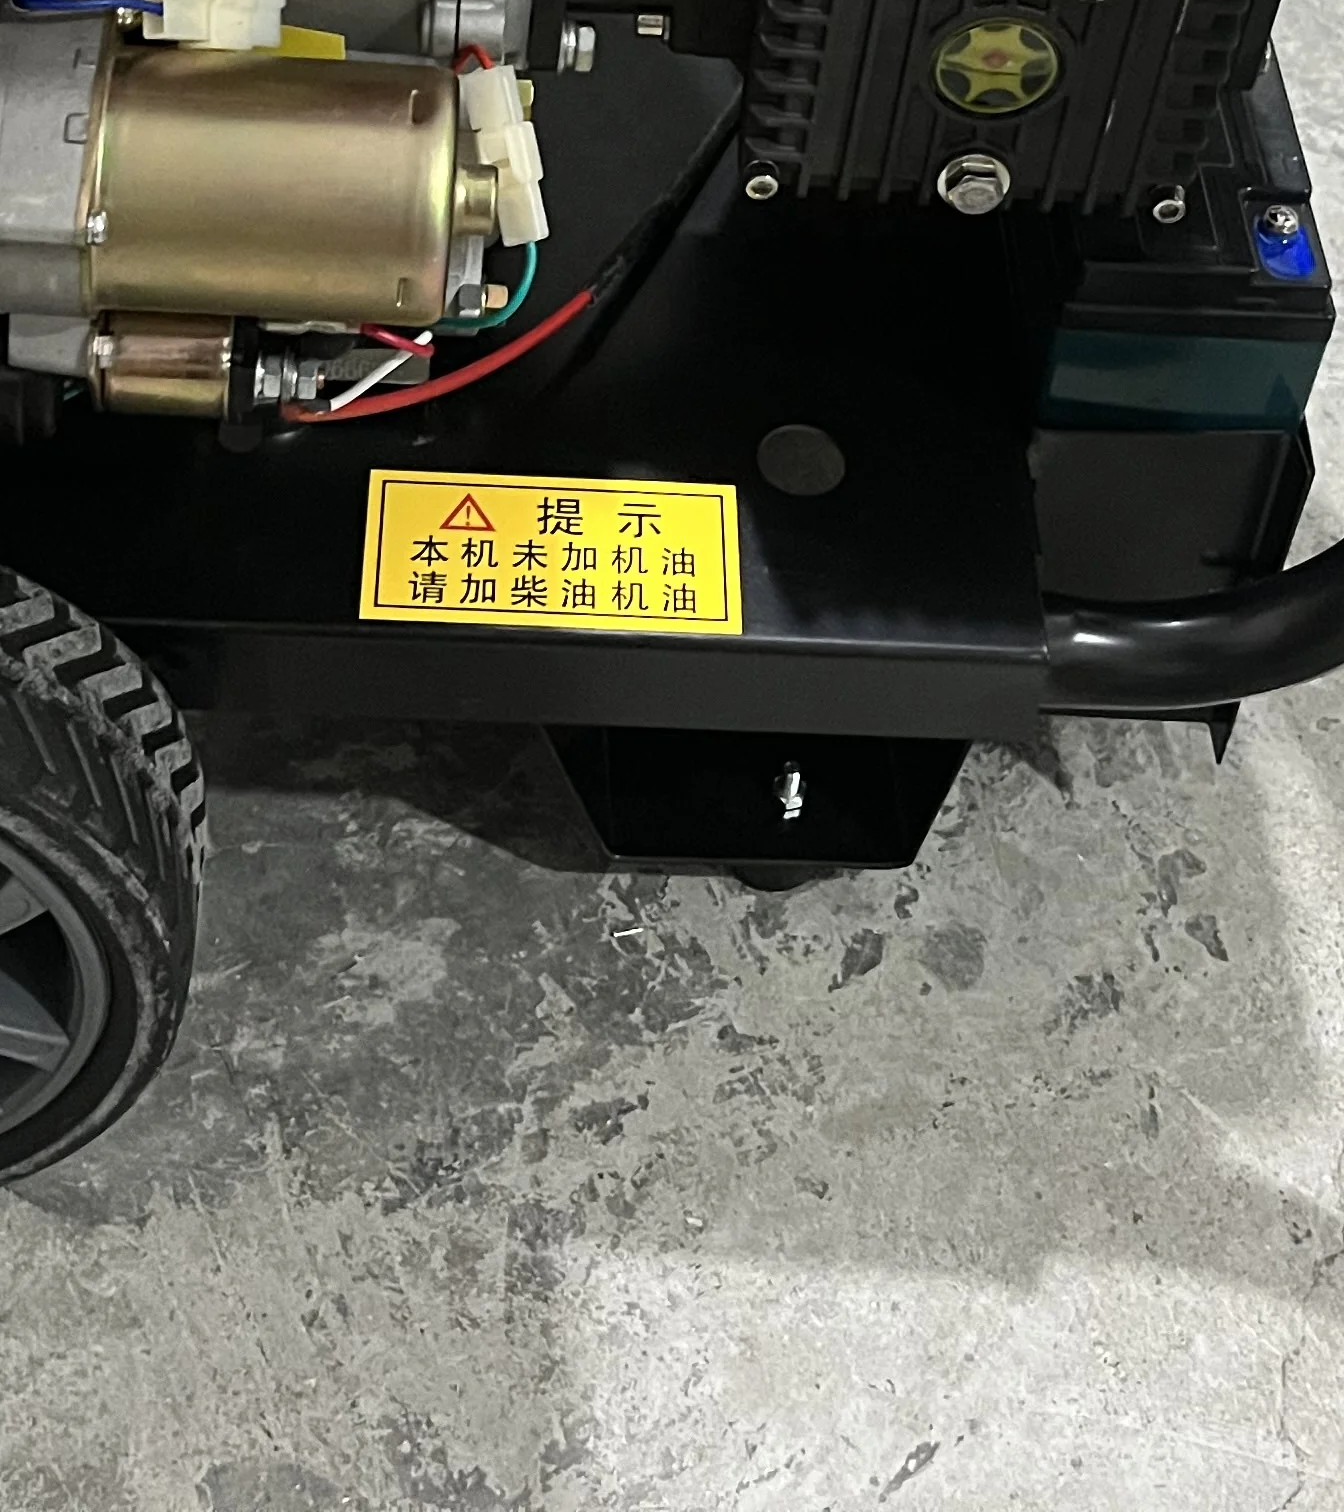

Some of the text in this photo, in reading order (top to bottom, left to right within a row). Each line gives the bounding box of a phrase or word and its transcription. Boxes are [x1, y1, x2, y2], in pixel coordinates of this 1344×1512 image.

[536, 496, 662, 538] 提示
[409, 534, 696, 577] 本机未加机油
[408, 571, 698, 614] 请加柴油机油
